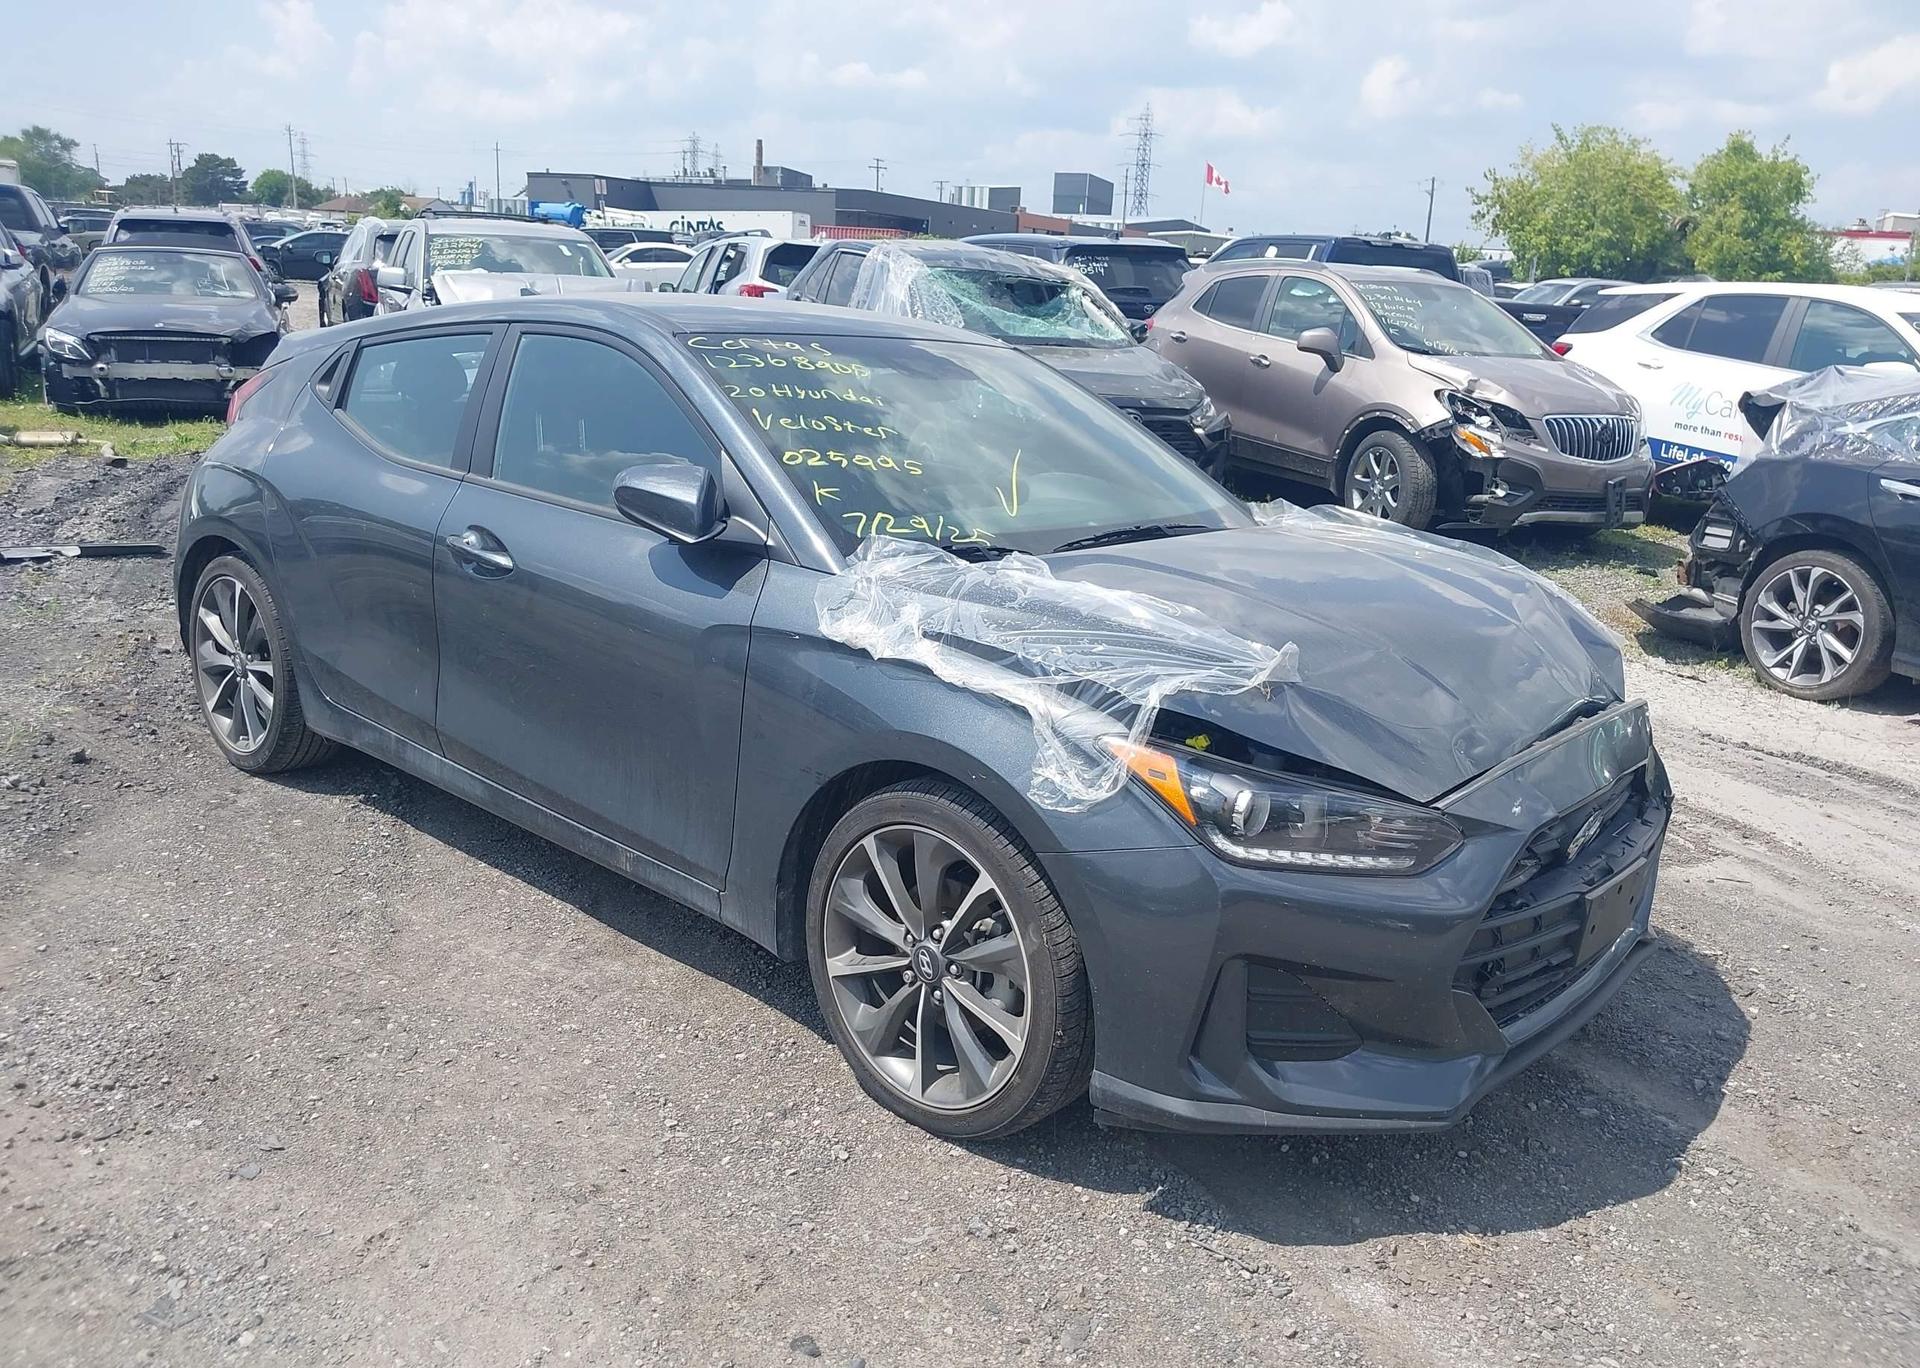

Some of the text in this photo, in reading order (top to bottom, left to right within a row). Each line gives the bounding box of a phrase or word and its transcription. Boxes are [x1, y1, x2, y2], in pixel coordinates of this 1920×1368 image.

[1080, 266, 1105, 277] 0514
[725, 383, 884, 407] 20 Hyundai
[752, 408, 899, 440] Veloster
[1674, 421, 1698, 433] more
[1700, 425, 1722, 438] than
[813, 480, 841, 506] K
